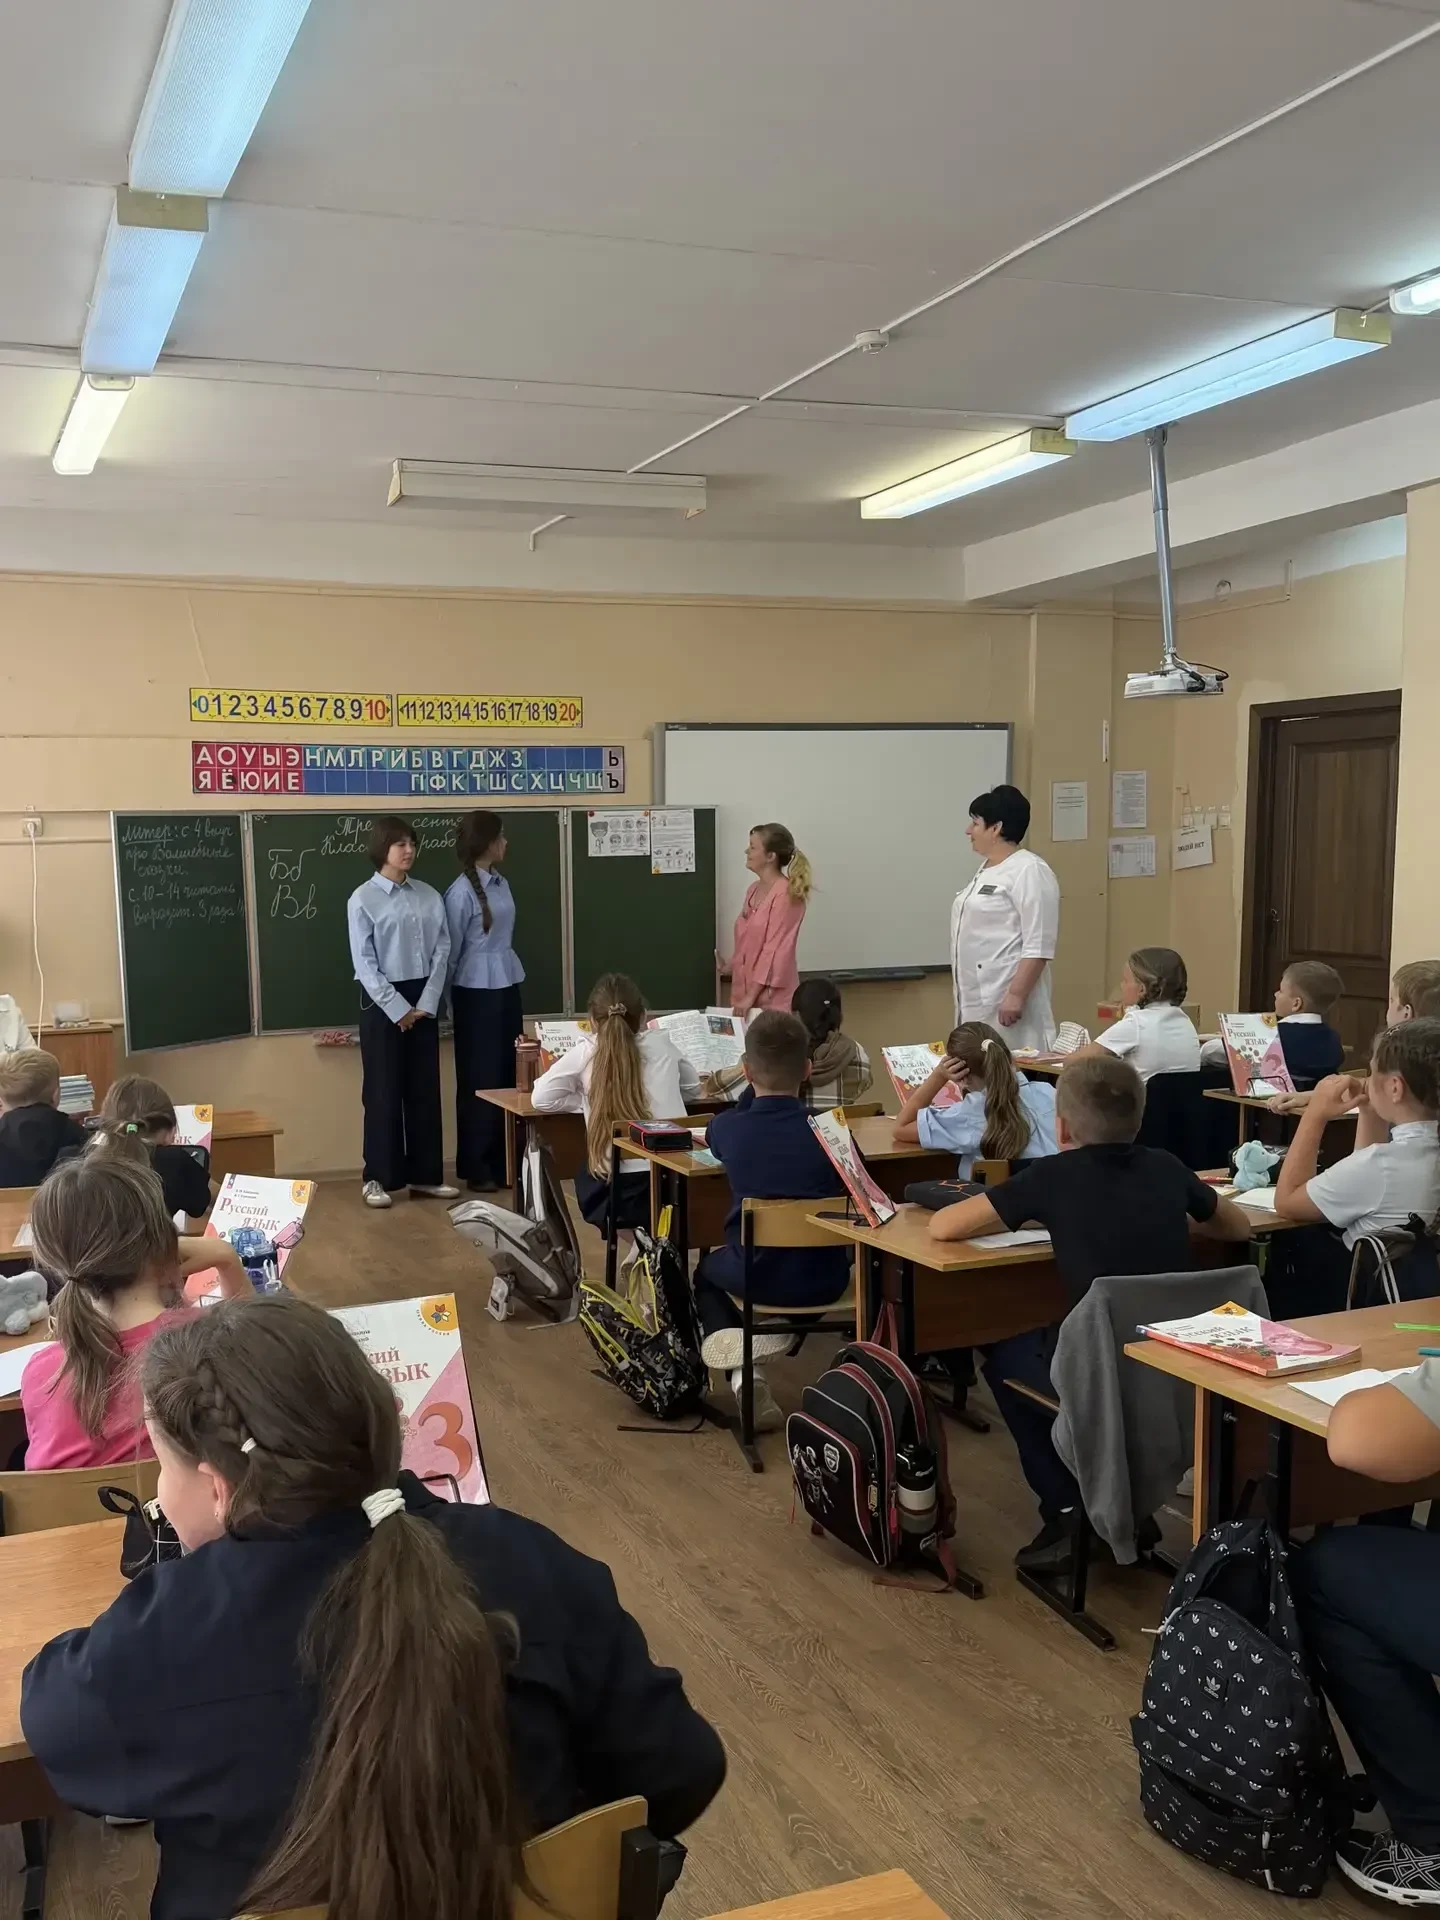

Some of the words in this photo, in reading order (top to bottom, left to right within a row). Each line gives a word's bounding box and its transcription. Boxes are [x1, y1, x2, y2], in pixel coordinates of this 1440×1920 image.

[335, 815, 373, 843] Тре
[416, 828, 457, 858] рабо
[268, 848, 316, 882] Бб
[218, 1197, 269, 1215] Русский
[418, 1401, 473, 1486] 3
